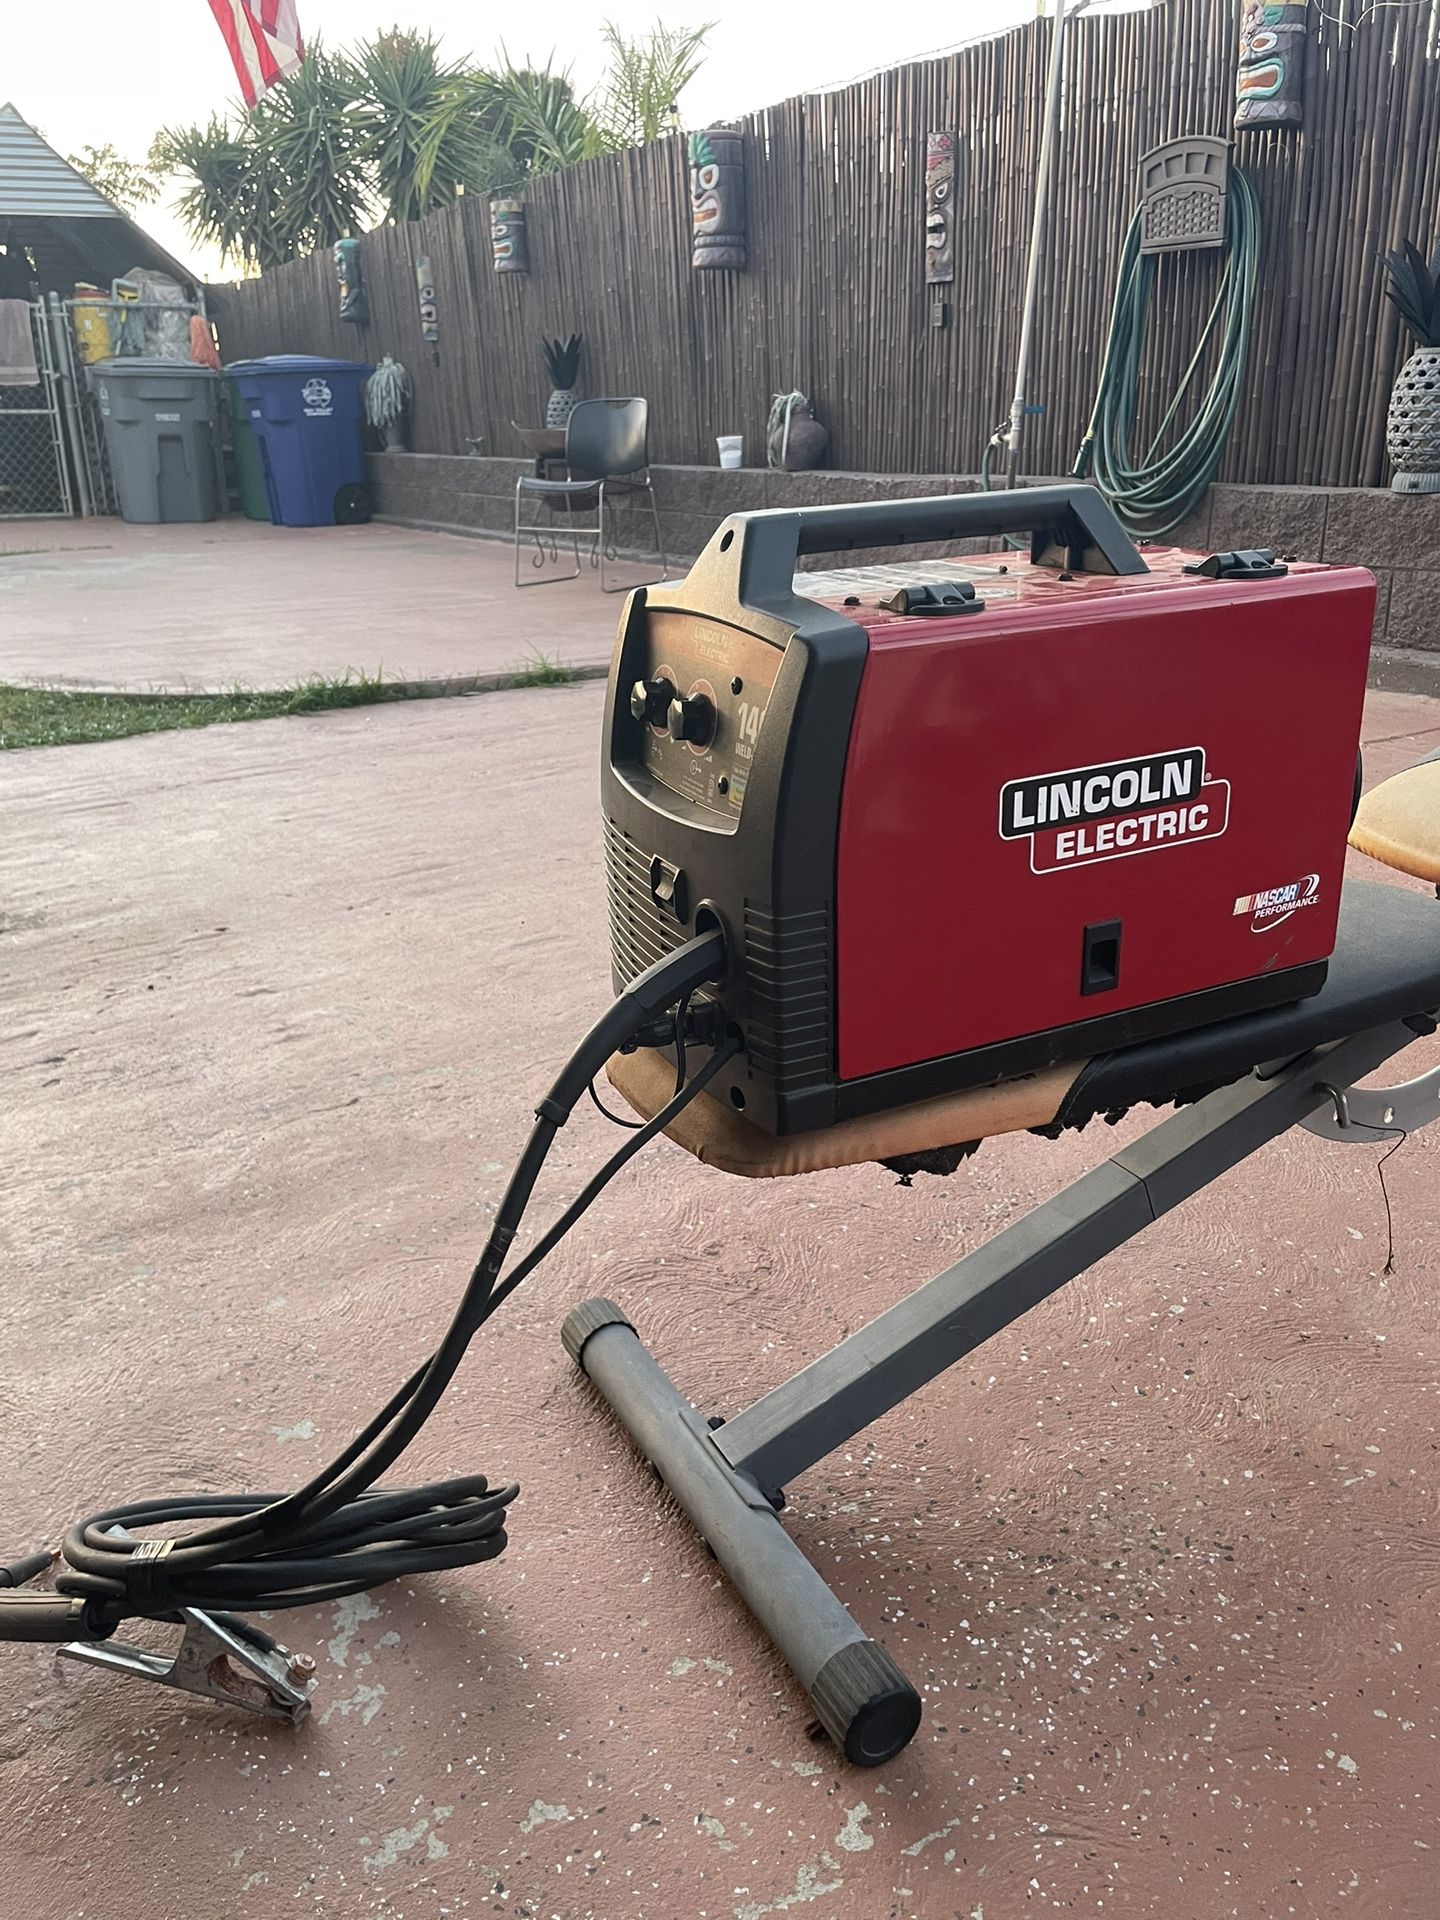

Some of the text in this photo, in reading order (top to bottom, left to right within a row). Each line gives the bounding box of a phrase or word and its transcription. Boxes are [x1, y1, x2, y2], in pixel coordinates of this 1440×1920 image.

[694, 624, 729, 648] LINCOLN
[699, 644, 731, 664] ELECTRIC
[1013, 759, 1193, 829] LINCOLN
[1055, 804, 1210, 861] ELECTRIC
[1254, 884, 1298, 910] NASCAR
[1254, 894, 1320, 919] PERFORMANCE
